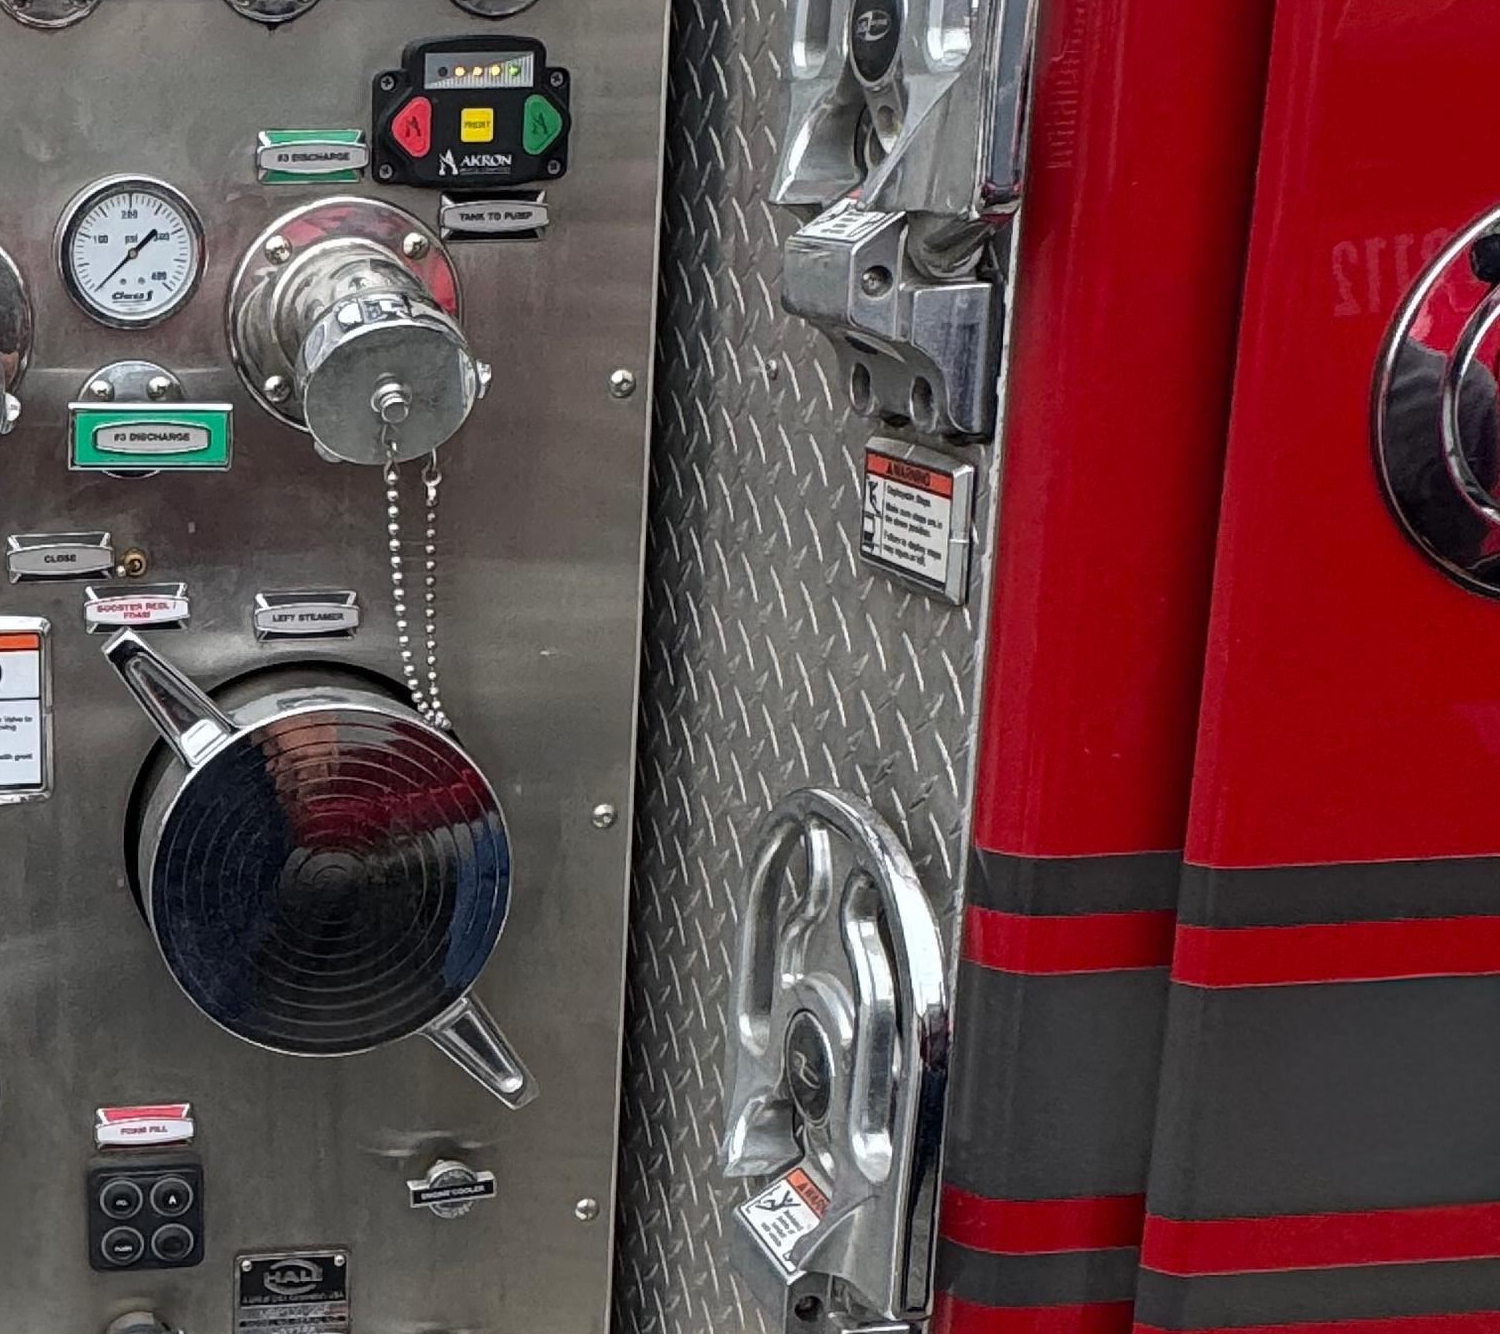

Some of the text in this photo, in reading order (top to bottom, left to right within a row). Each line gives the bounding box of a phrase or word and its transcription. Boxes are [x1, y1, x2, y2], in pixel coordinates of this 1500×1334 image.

[292, 152, 350, 162] DISCHARGE
[460, 155, 512, 167] AKRON
[460, 211, 532, 222] TANK TO PUMP
[129, 432, 190, 442] DISCHARGE
[44, 554, 77, 564] CLOSE
[97, 603, 143, 612] BOOSTER
[124, 611, 150, 619] FOAM
[272, 613, 344, 623] LEFT STEAMER
[149, 1125, 168, 1133] FILL
[421, 1185, 485, 1200] ENGINE COOLER
